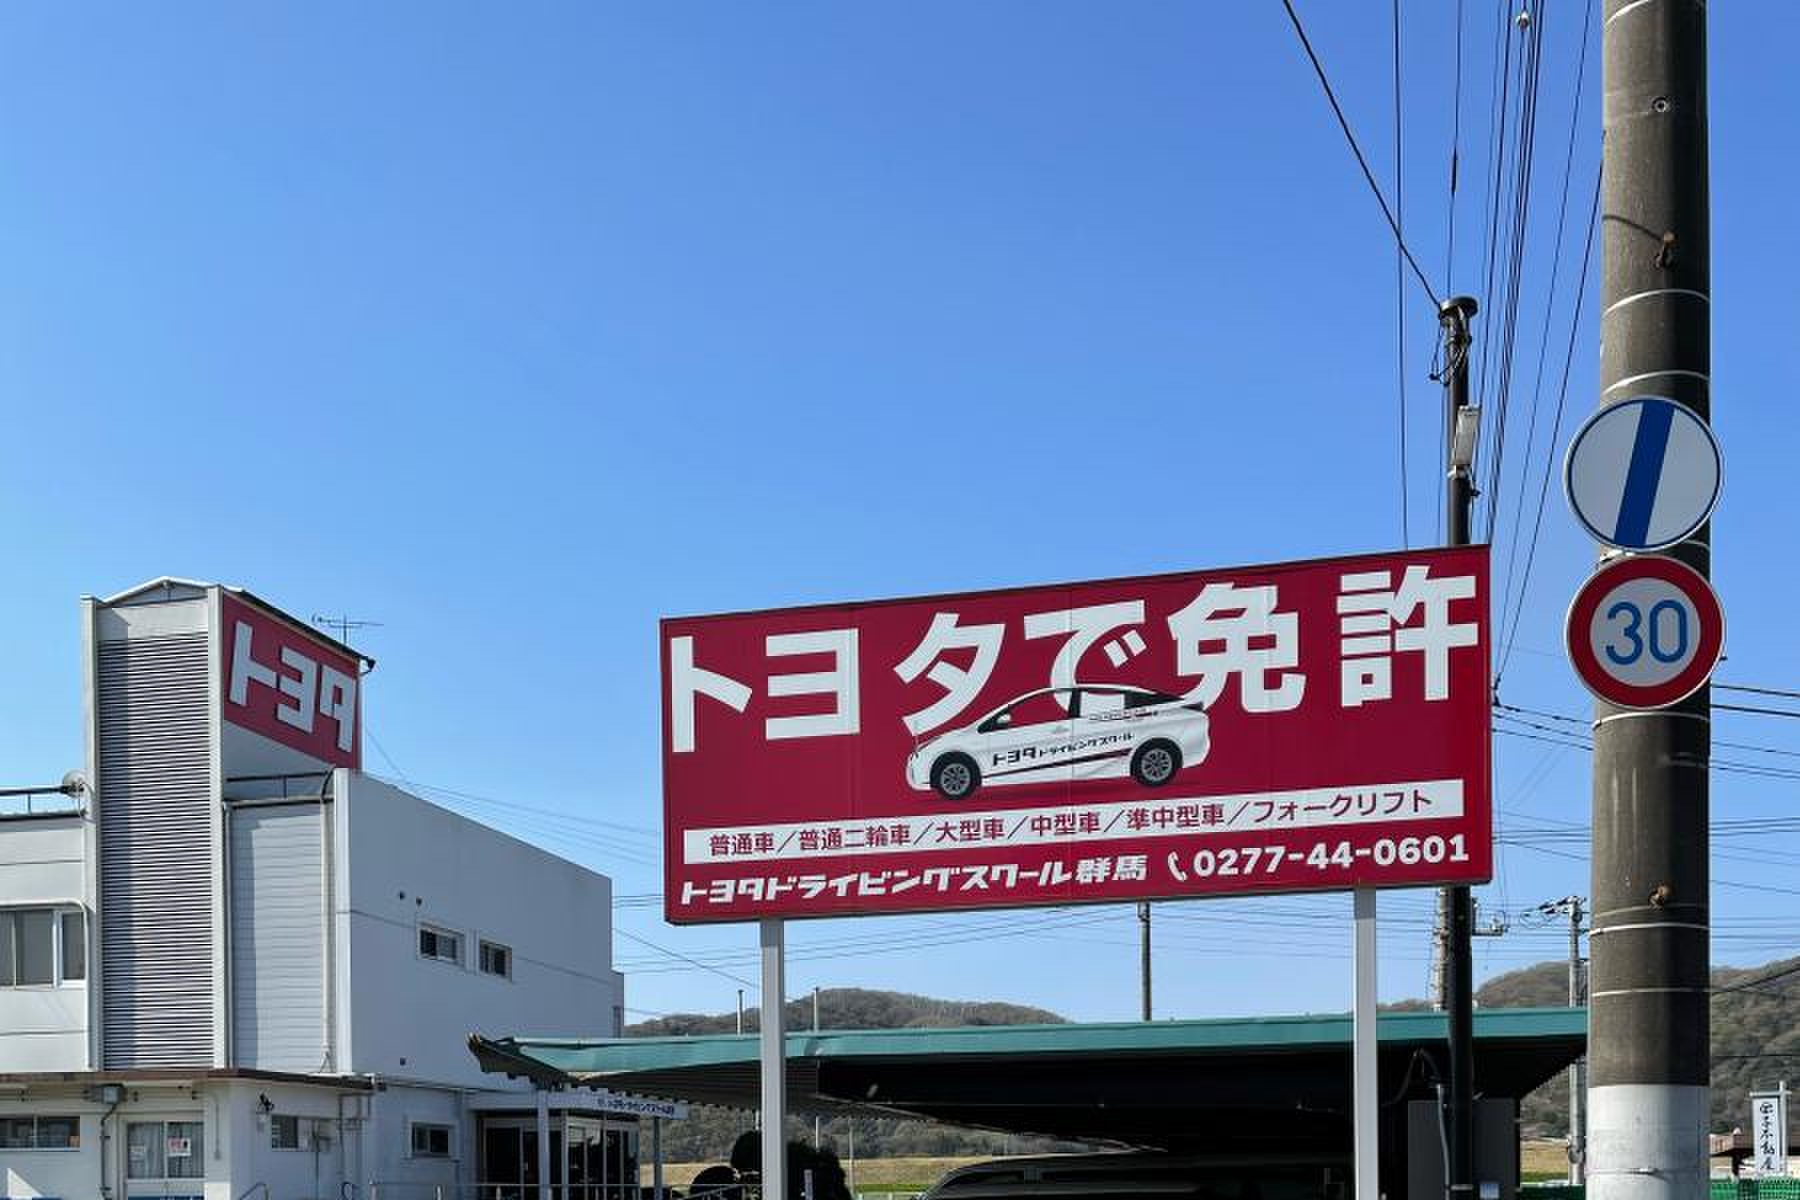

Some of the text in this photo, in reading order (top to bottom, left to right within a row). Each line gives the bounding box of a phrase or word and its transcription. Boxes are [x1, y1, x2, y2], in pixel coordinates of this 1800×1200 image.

[671, 566, 1480, 753] トヨタで免許
[1605, 600, 1688, 665] 30
[229, 619, 357, 753] トヨタ
[1193, 834, 1469, 879] 0277-44-0601
